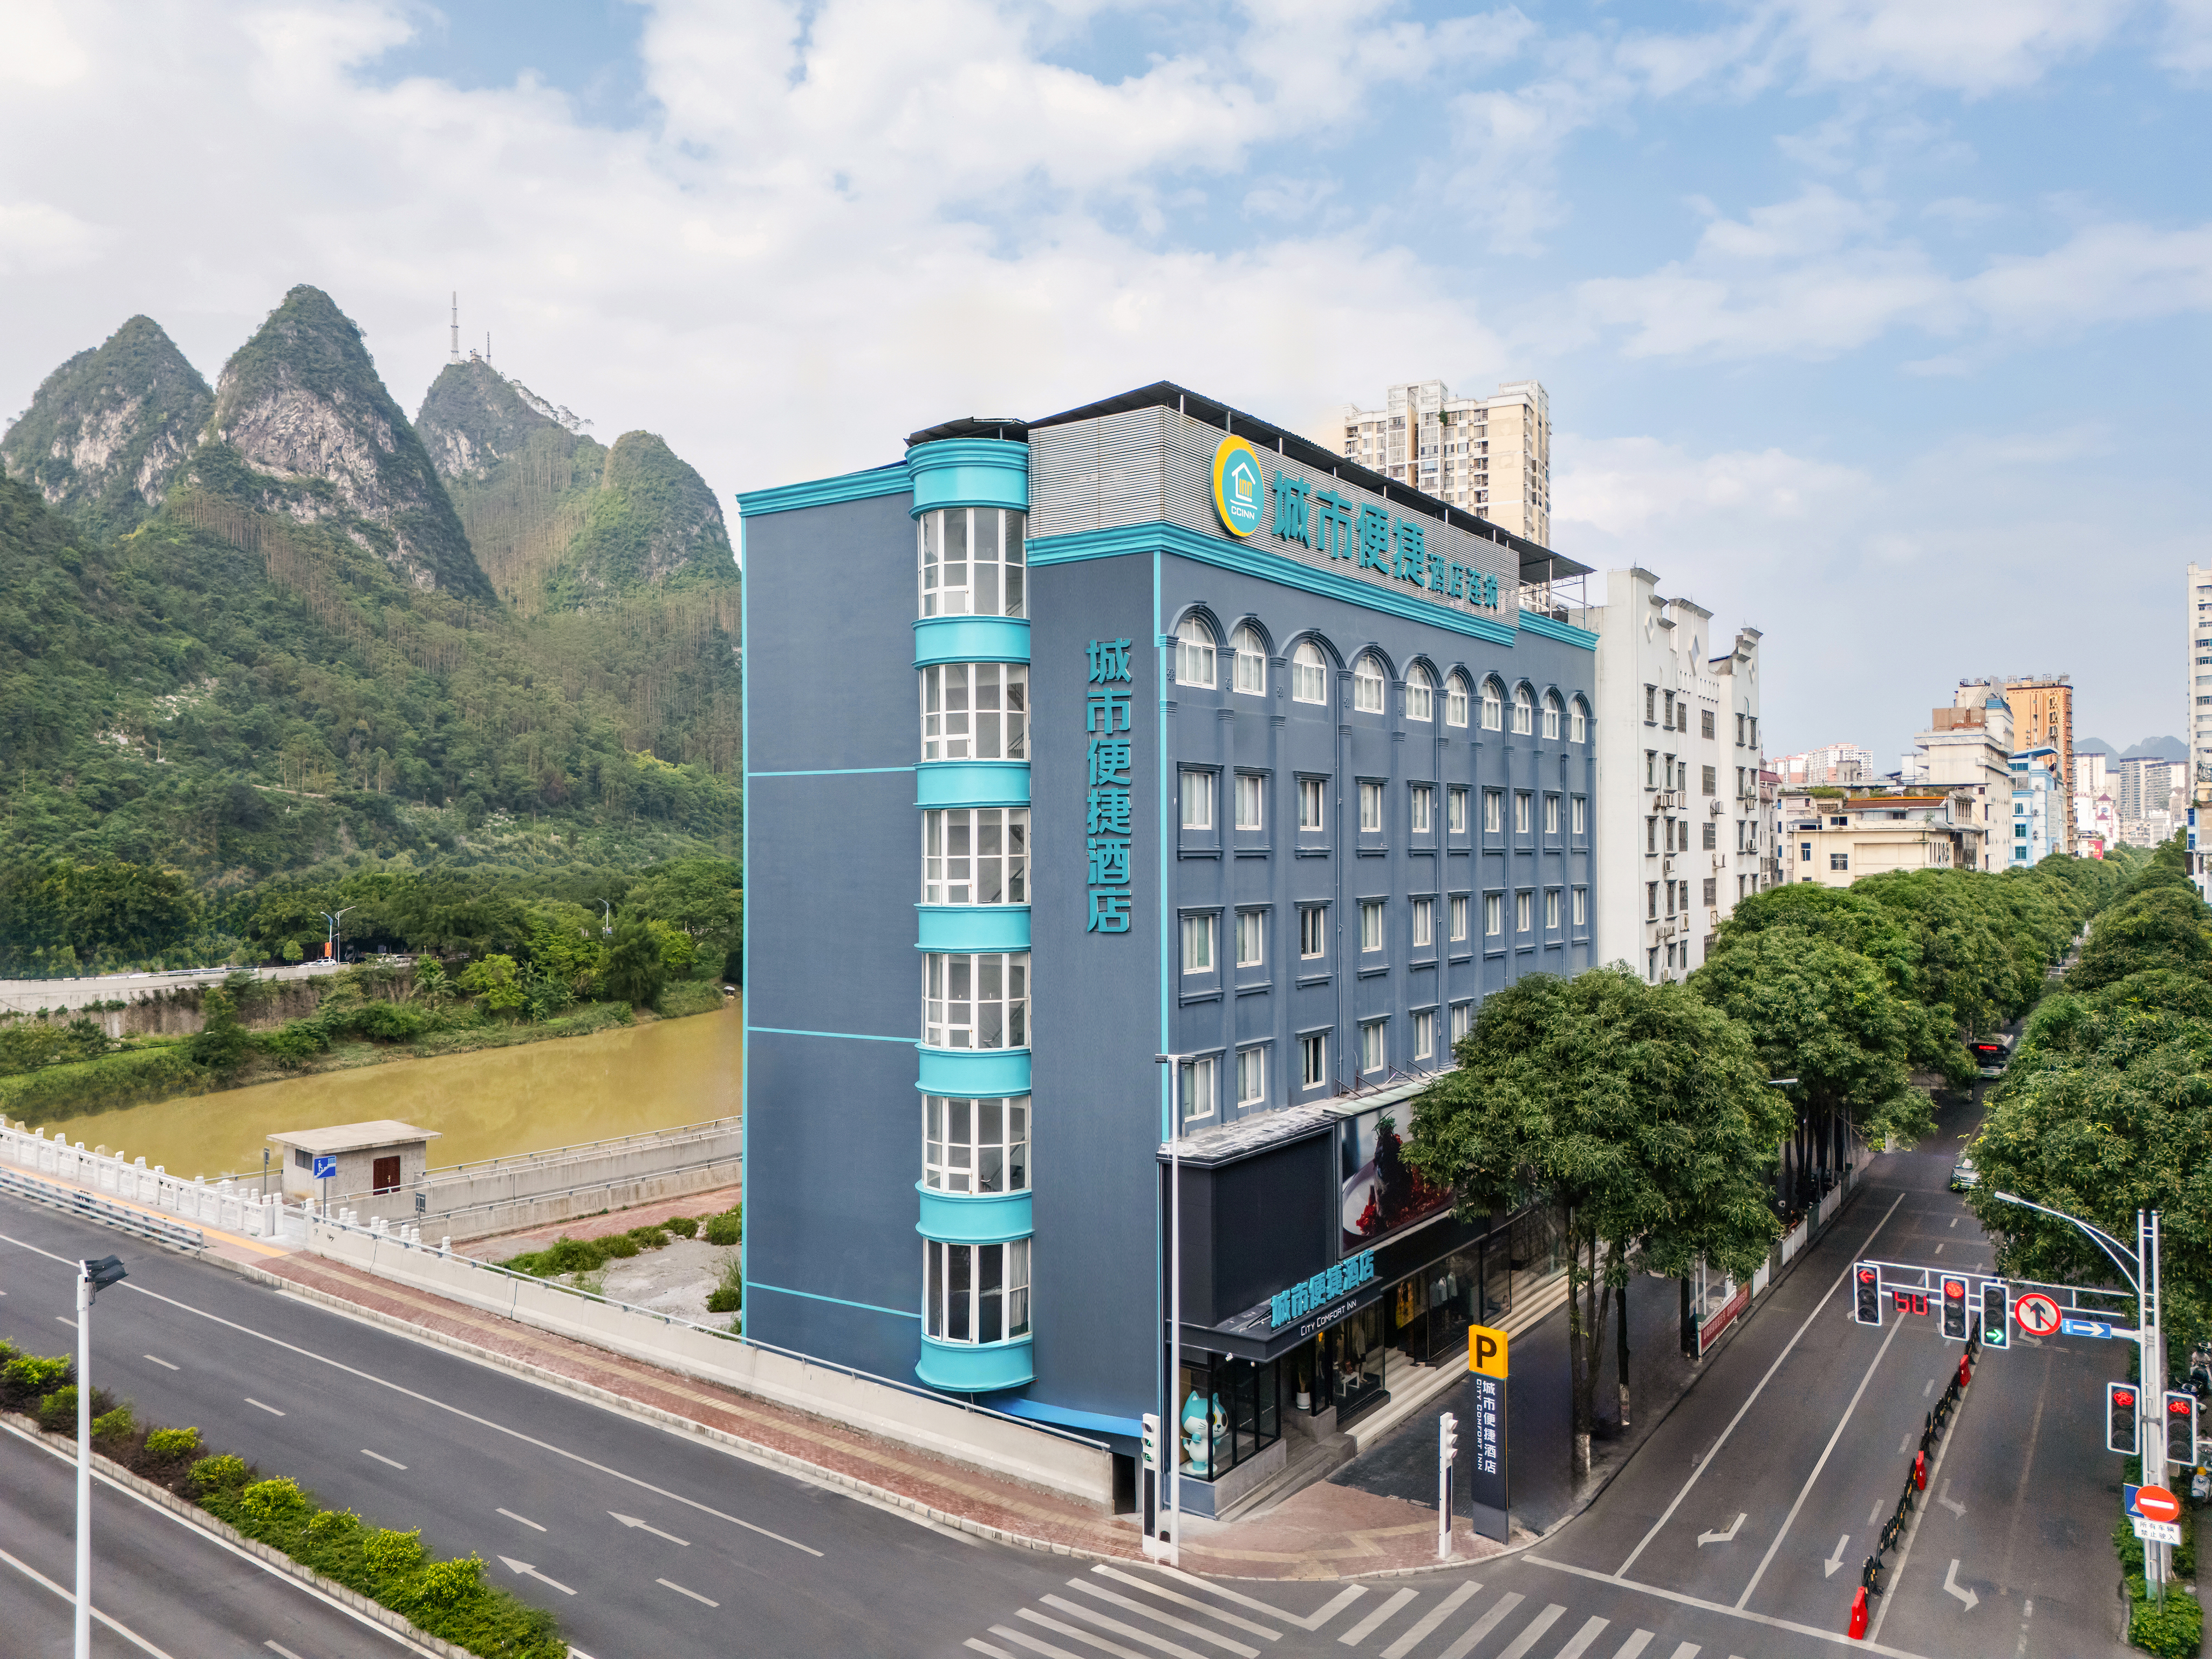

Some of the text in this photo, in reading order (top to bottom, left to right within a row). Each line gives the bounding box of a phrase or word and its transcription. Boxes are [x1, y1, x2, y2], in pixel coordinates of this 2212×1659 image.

[1231, 506, 1255, 520] CCINN
[1272, 470, 1498, 610] 城市便捷酒店连锁
[1085, 638, 1132, 933] 城市便捷酒店
[1271, 1249, 1374, 1328] 城市便捷酒店
[1301, 1299, 1356, 1336] CITY COMFORT INN
[1476, 1334, 1497, 1369] P
[1483, 1381, 1497, 1474] 城市便捷酒店
[2140, 1521, 2175, 1533] 所有车辆
[2140, 1529, 2176, 1541] 禁止驶入
